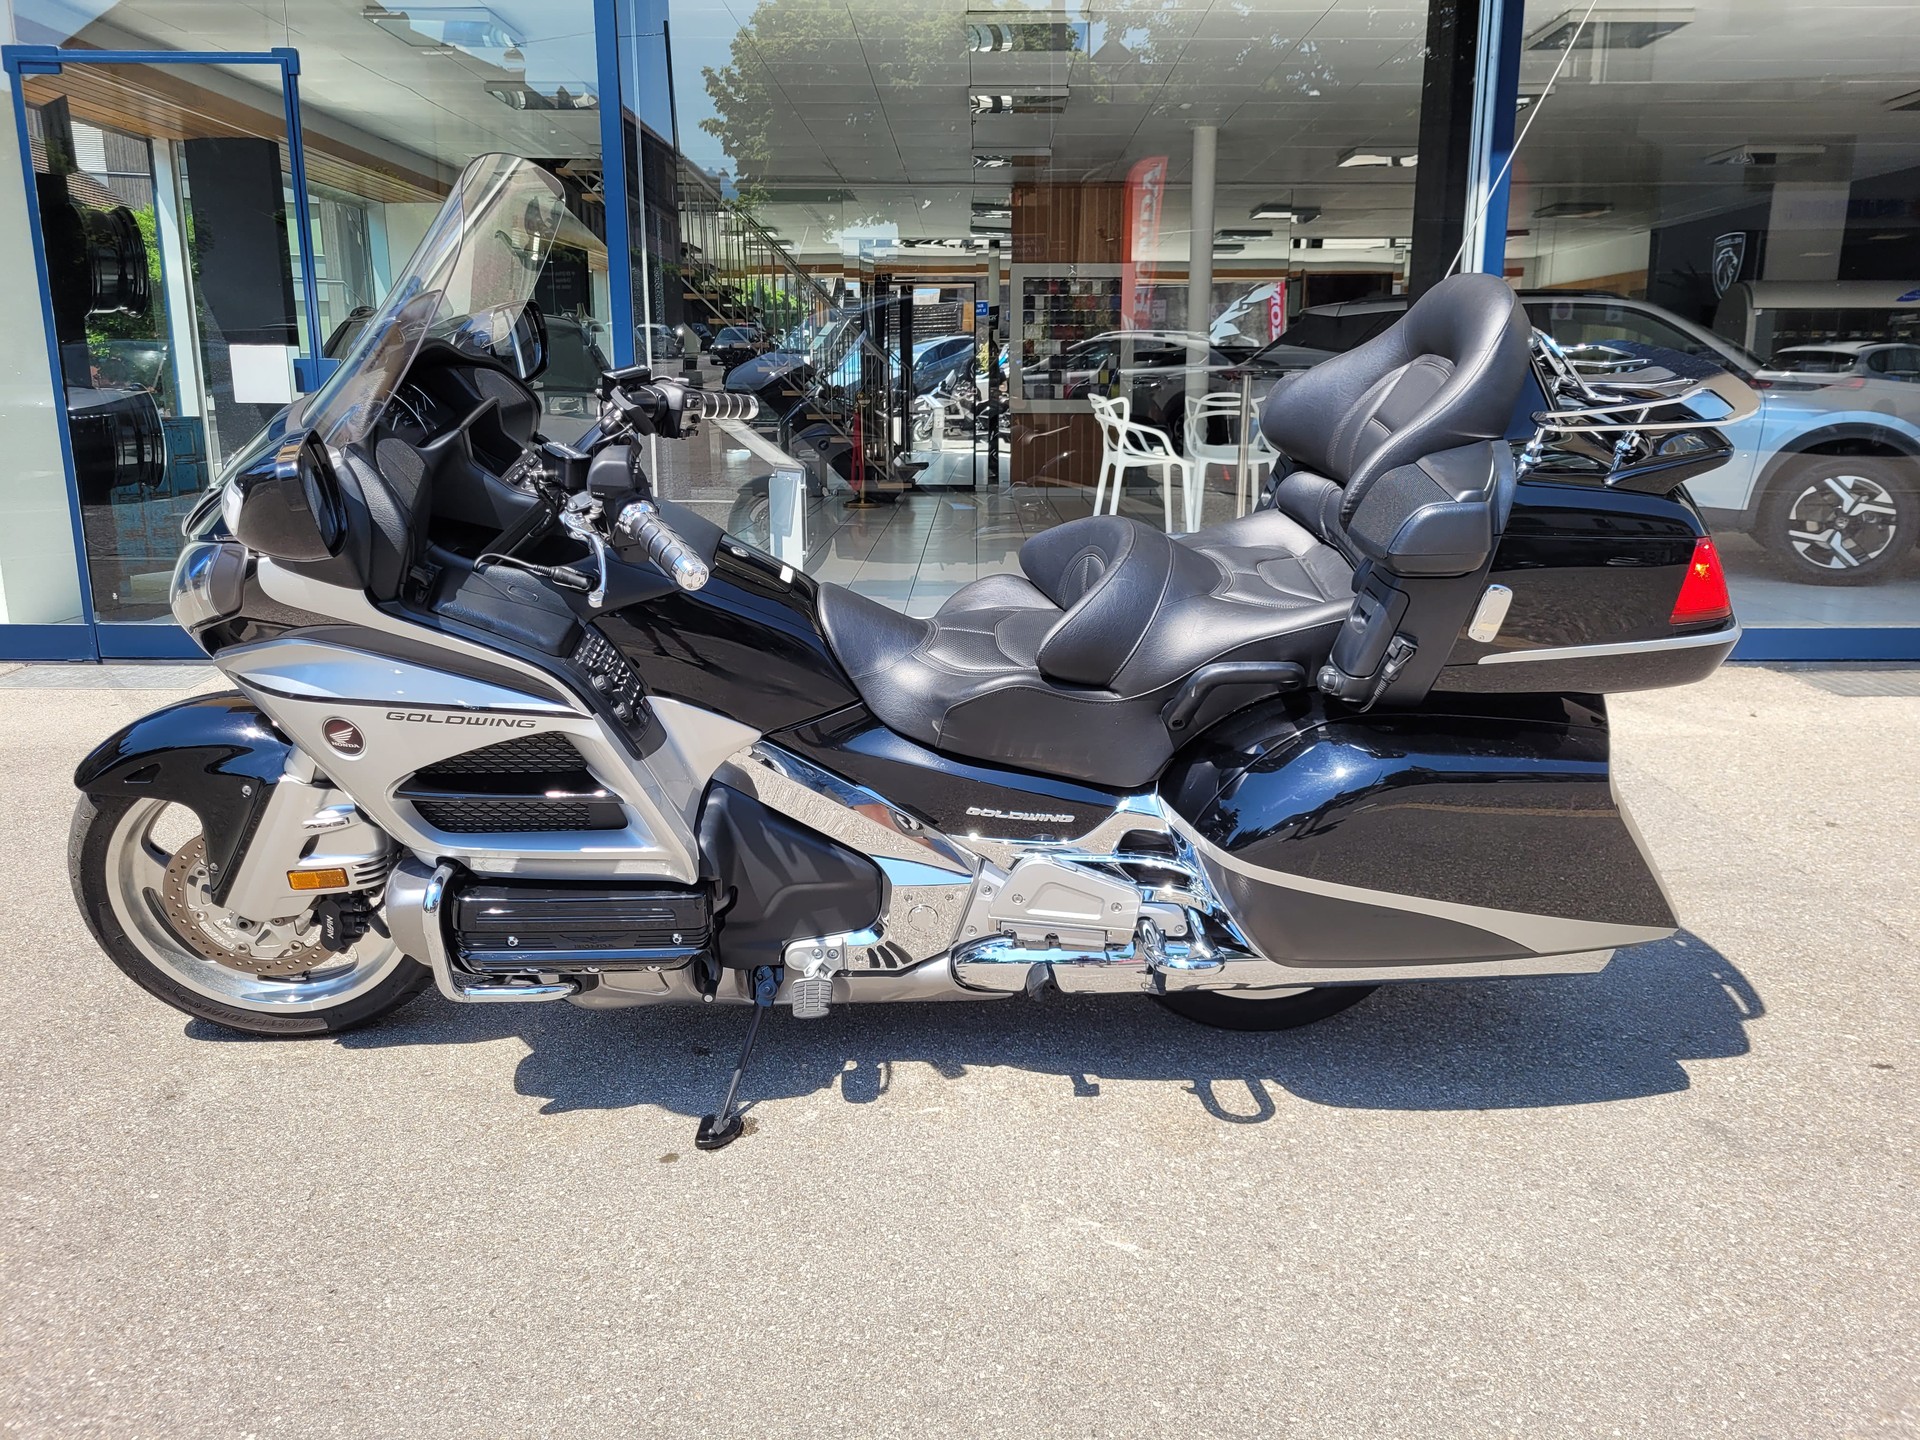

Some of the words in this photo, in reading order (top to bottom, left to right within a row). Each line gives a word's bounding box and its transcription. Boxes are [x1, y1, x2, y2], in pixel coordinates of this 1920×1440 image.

[386, 712, 536, 728] GOLDWING
[331, 741, 361, 749] HONDA
[966, 807, 1075, 823] GOLDWING
